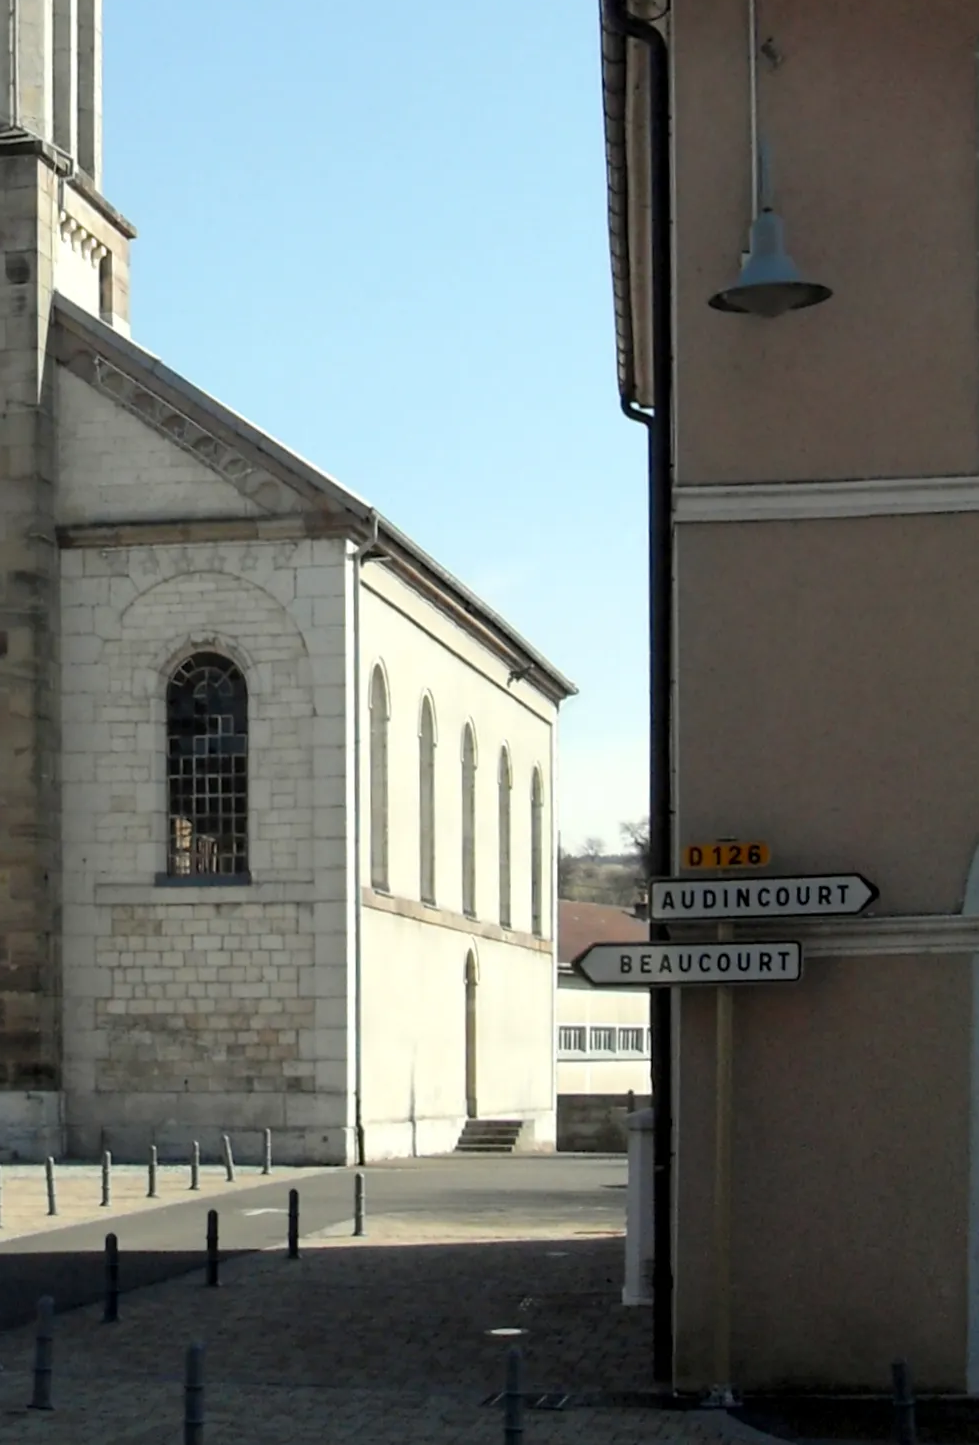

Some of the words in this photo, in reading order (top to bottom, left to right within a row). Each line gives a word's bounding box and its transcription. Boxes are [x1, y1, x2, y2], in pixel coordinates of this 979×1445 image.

[688, 846, 703, 867] D
[712, 844, 762, 866] 126
[661, 884, 850, 910] AUDINCOURT
[620, 951, 791, 974] BEAUCOURT
